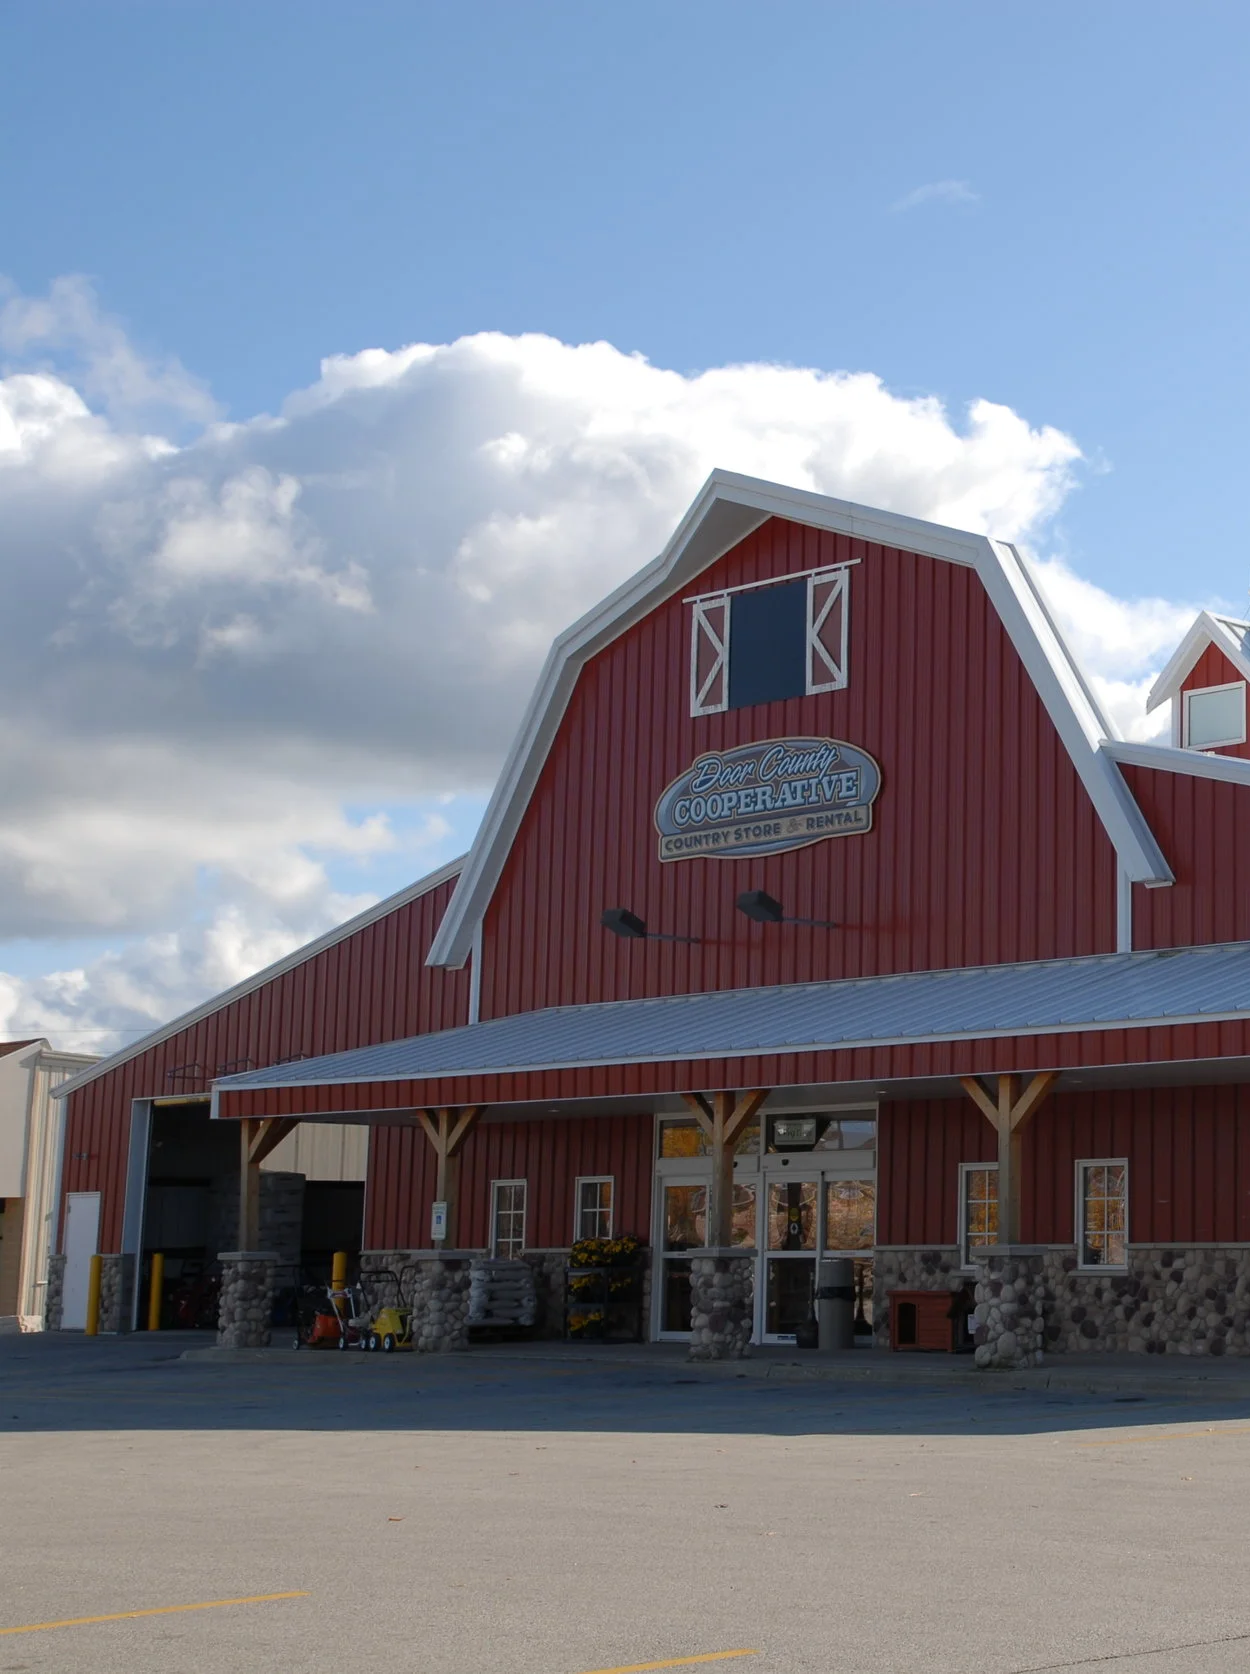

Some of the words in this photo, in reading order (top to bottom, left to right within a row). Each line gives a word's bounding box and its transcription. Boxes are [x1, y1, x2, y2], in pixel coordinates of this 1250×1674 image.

[691, 758, 754, 793] Door
[759, 744, 838, 780] County
[674, 770, 859, 826] COOPERATIVE
[664, 831, 731, 852] COUNTRY
[734, 822, 781, 841] STORE
[786, 818, 801, 834] &
[806, 810, 864, 831] RENTAL
